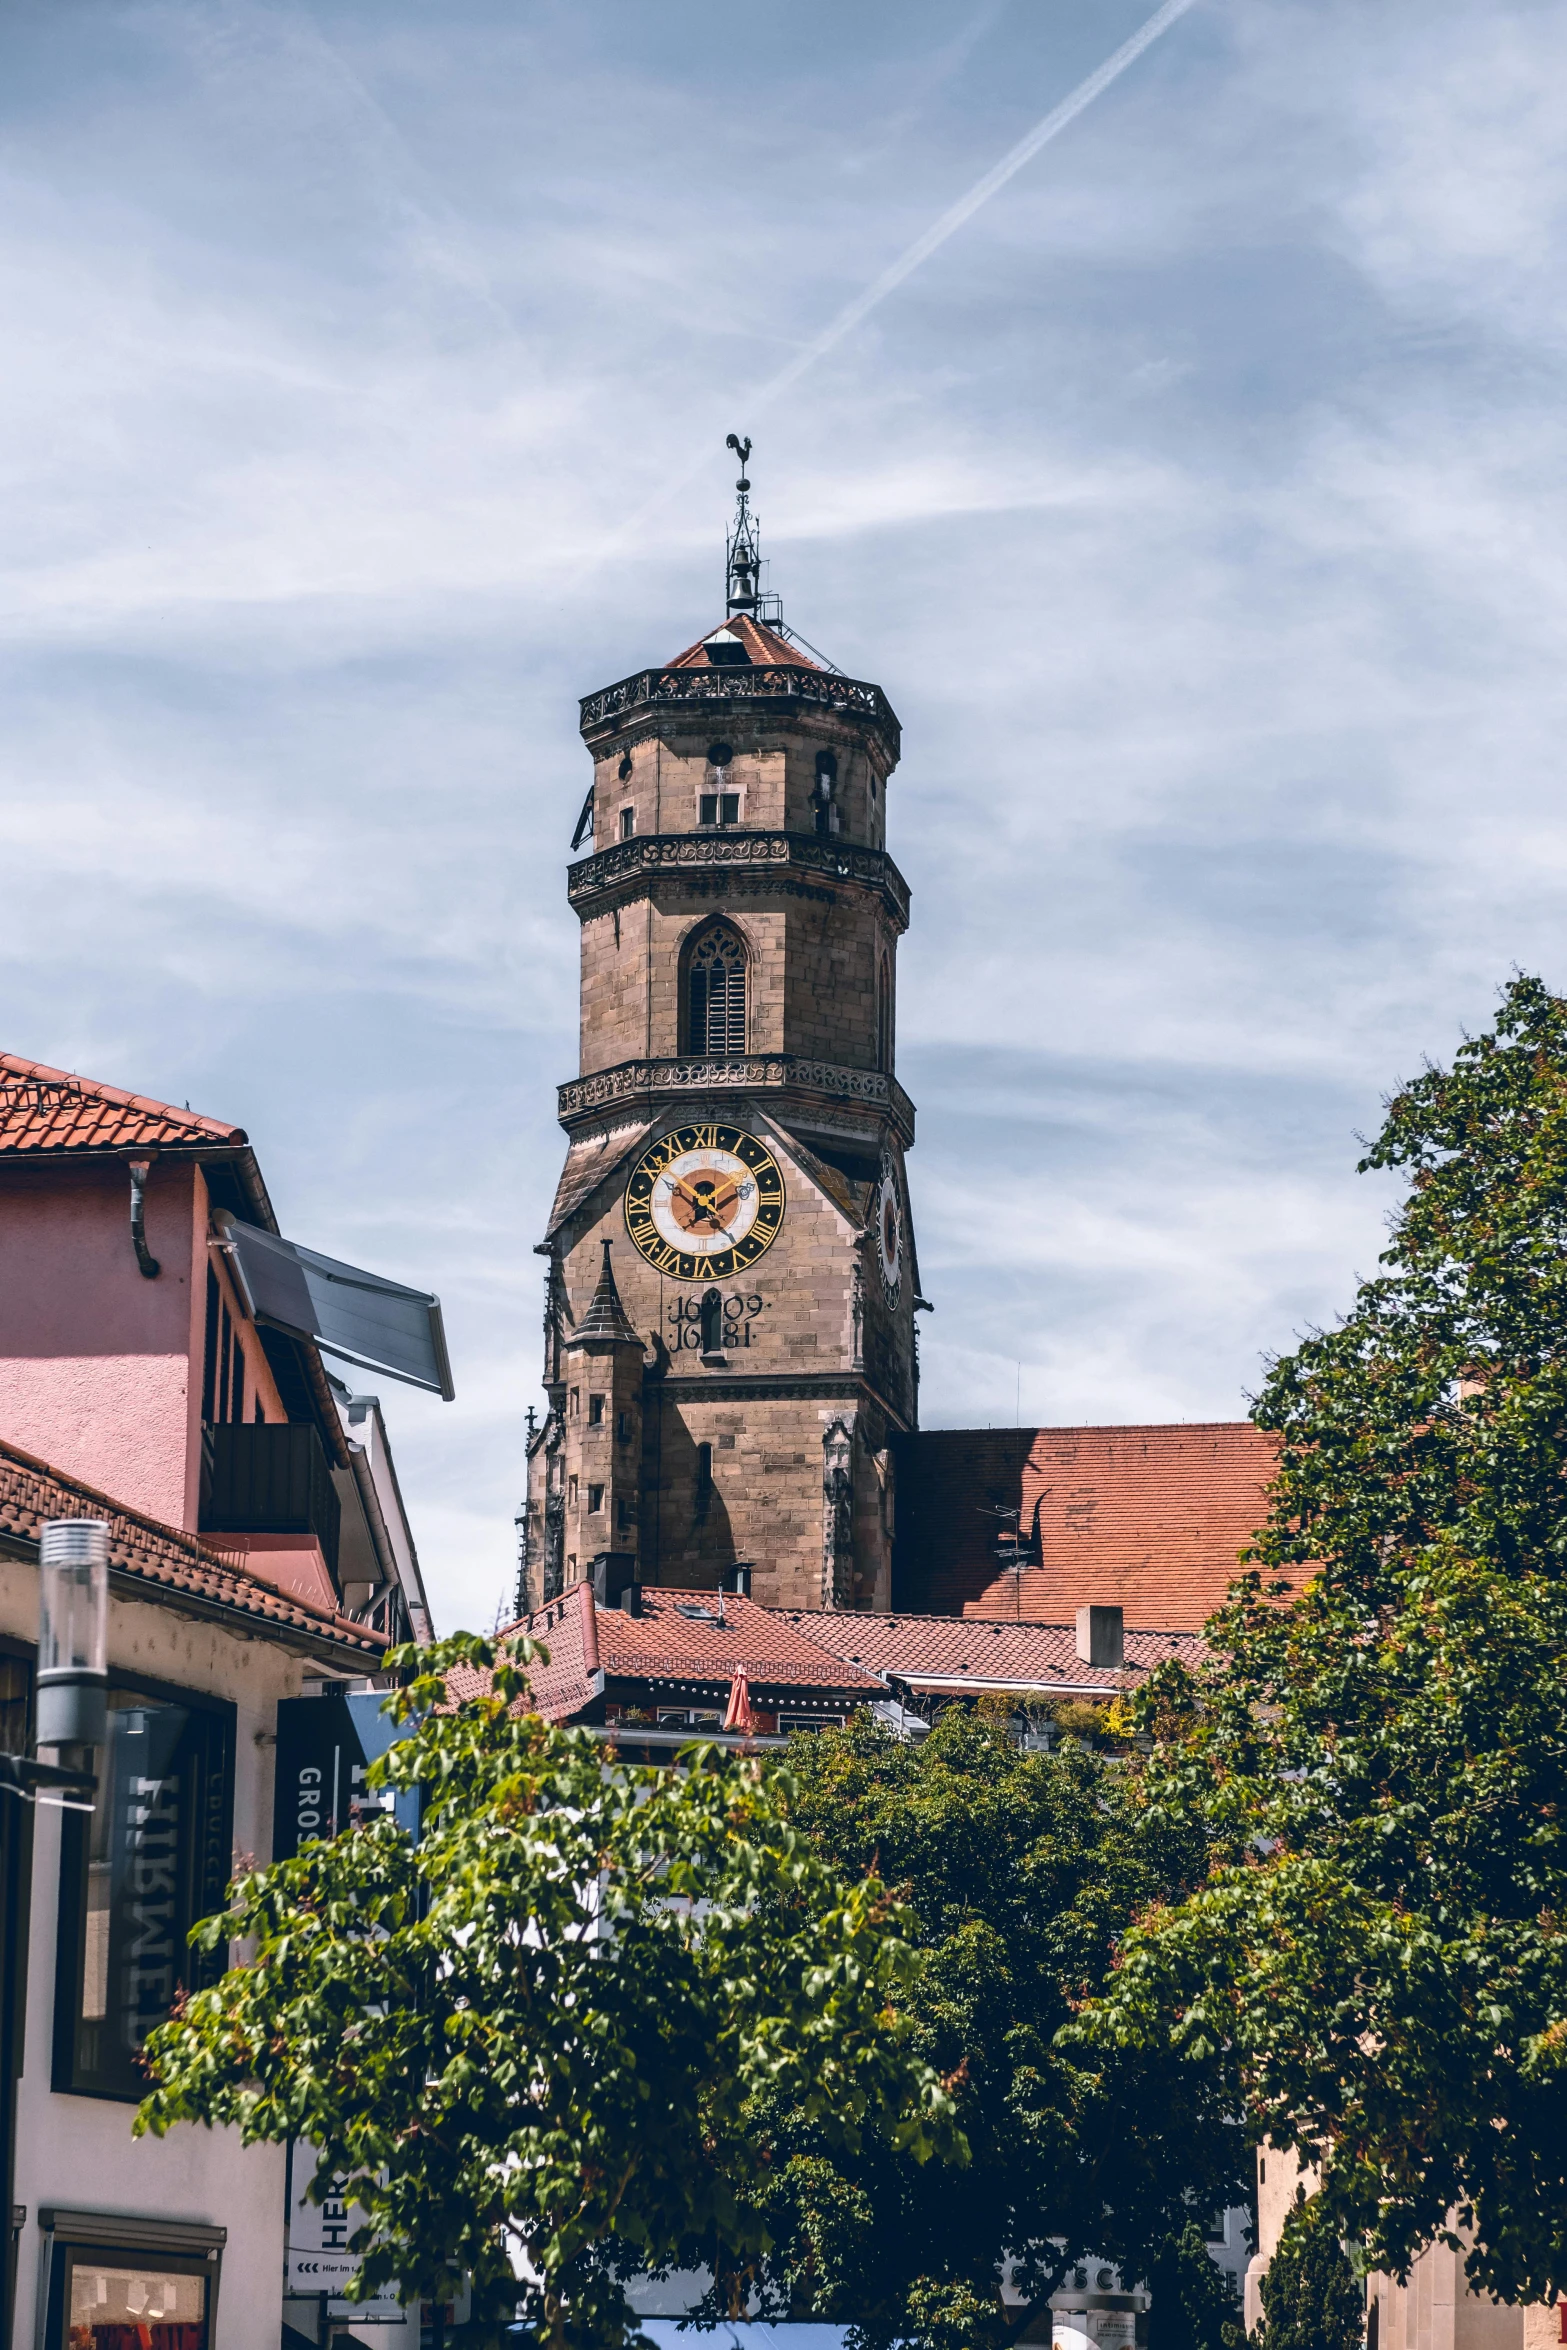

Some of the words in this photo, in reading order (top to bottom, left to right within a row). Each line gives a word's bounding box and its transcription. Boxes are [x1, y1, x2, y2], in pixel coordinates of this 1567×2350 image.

[660, 1134, 686, 1162] XI
[692, 1127, 718, 1148] XII
[732, 1134, 746, 1154] I
[752, 1157, 774, 1176] II
[630, 1194, 650, 1214] IX
[760, 1190, 780, 1207] III
[632, 1221, 657, 1257] VIII
[748, 1218, 776, 1247] IIII
[655, 1244, 681, 1274] VII
[692, 1257, 717, 1278] VI
[732, 1249, 752, 1270] V
[322, 2264, 338, 2272] Hier
